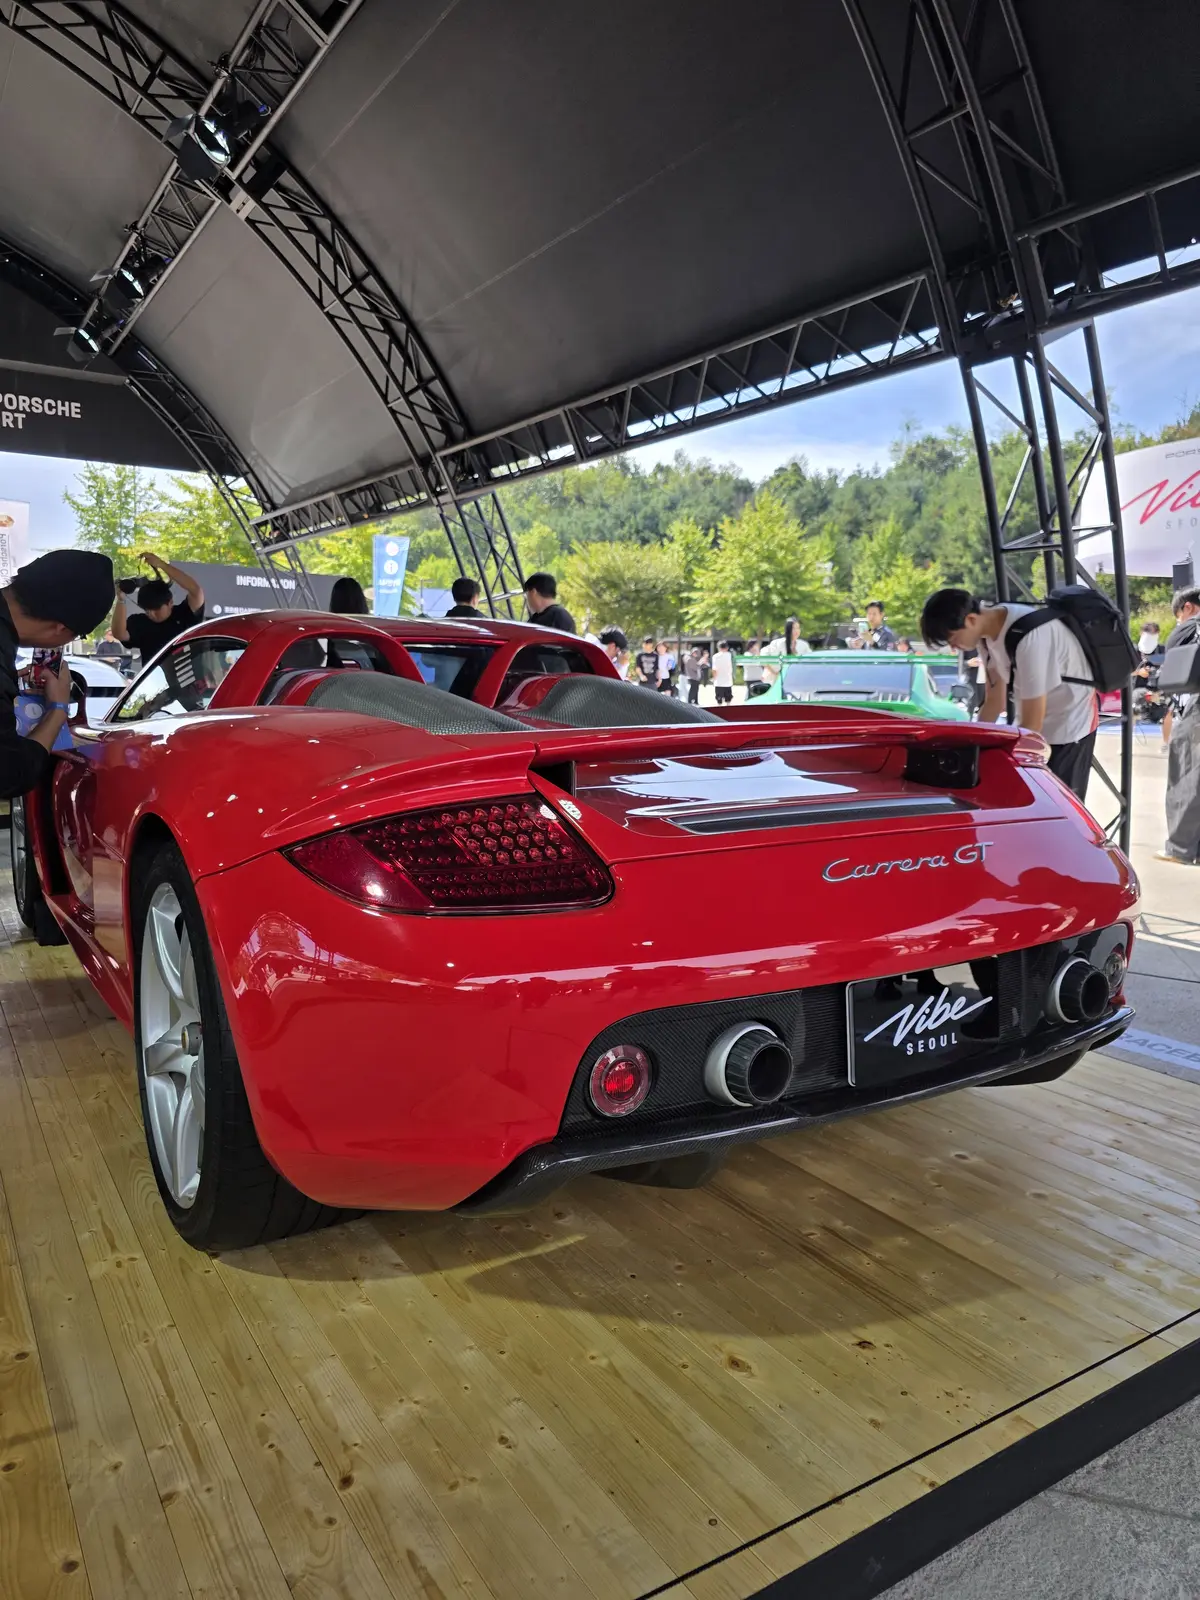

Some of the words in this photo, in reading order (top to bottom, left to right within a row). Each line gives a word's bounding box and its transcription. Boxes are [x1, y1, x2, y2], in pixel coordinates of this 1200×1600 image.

[0, 393, 81, 418] ORSCHE
[1165, 448, 1200, 459] POR
[822, 855, 950, 882] Carrera
[954, 841, 994, 864] GT
[863, 986, 993, 1047] Vibe
[906, 1032, 958, 1056] SEOUL
